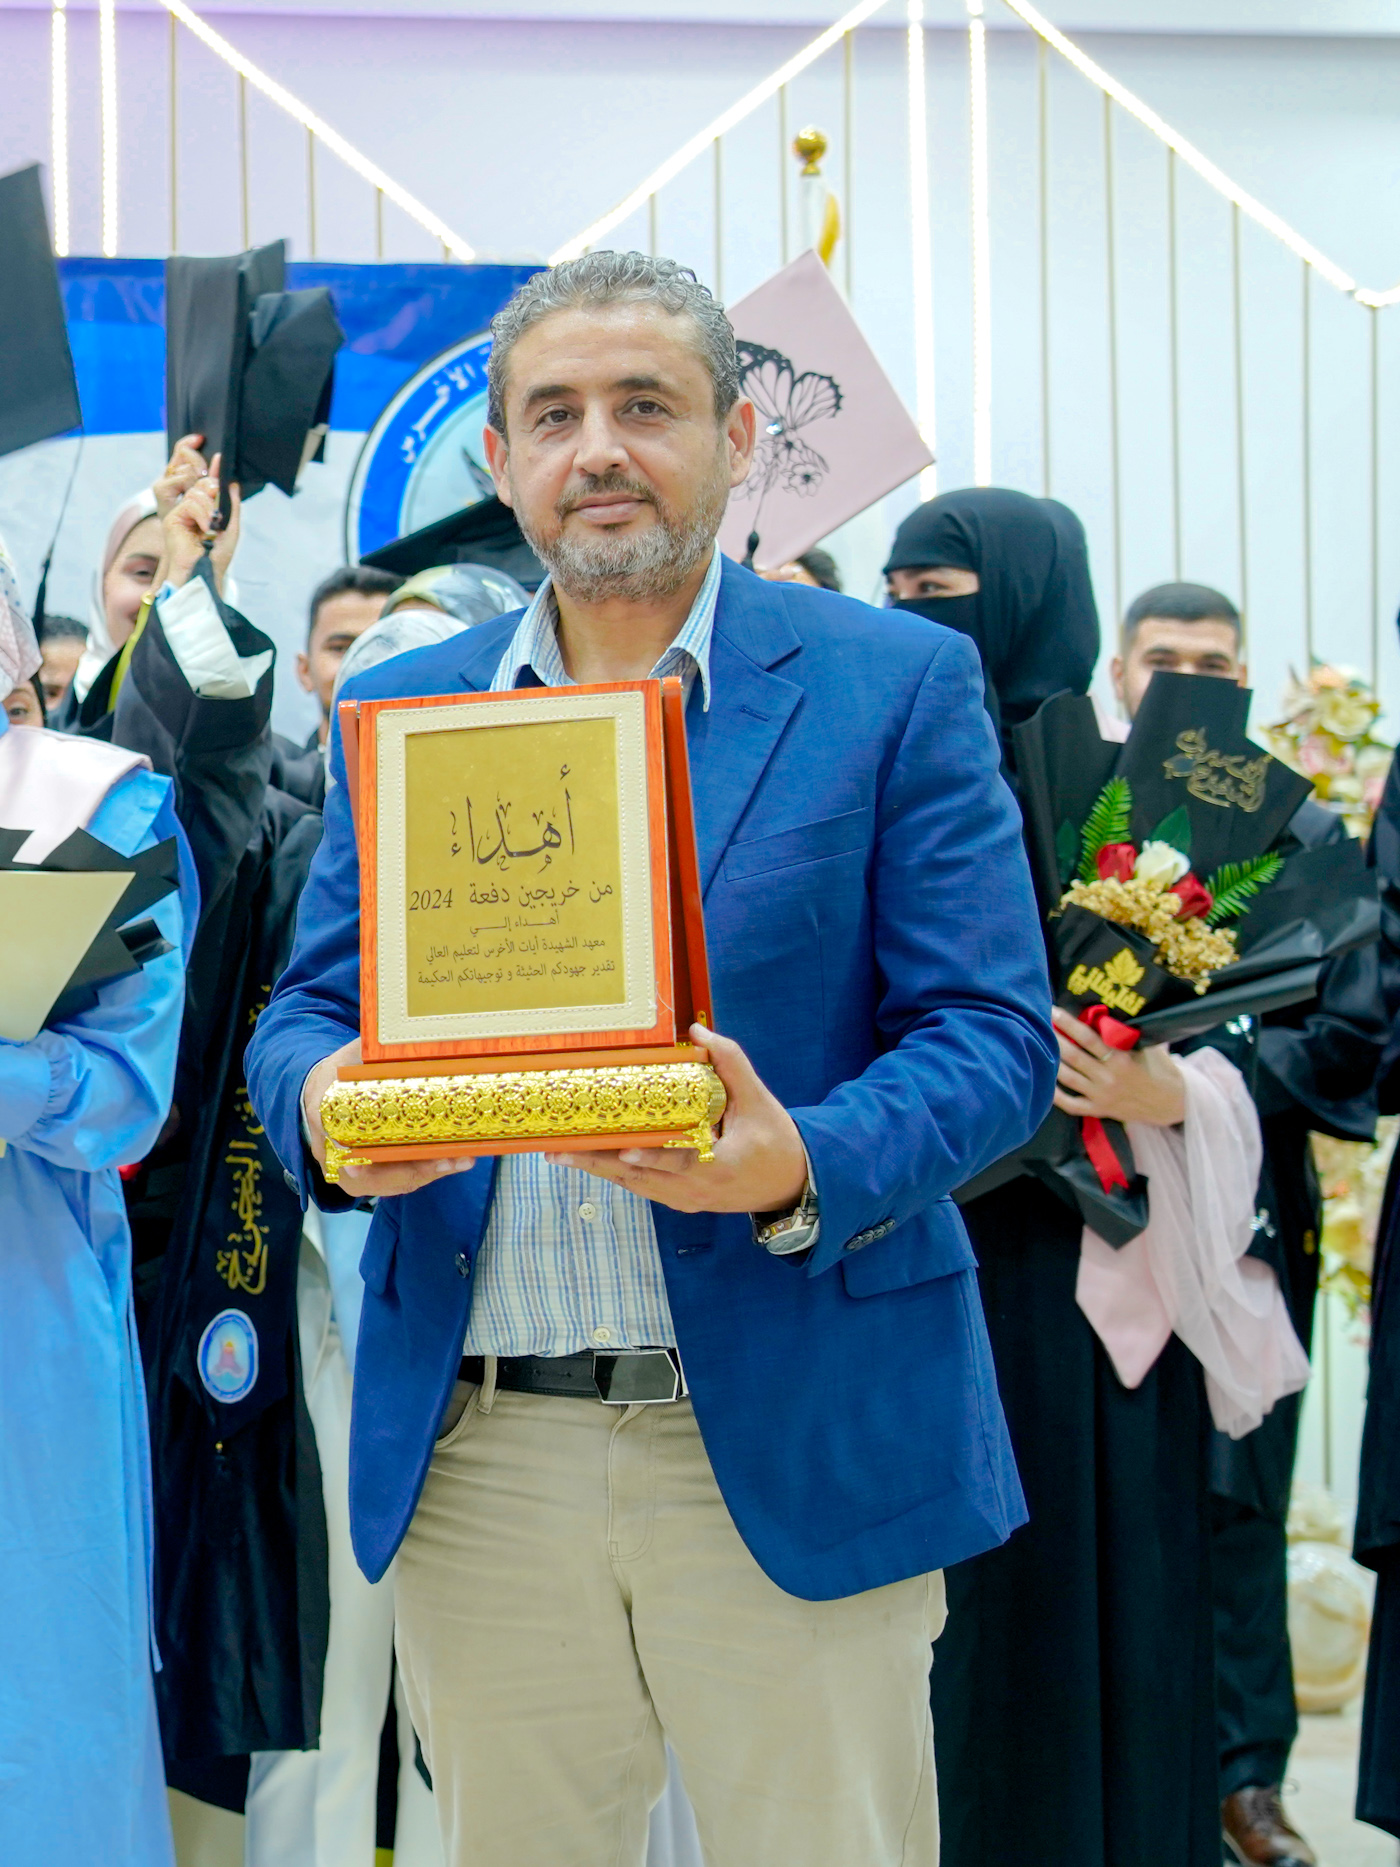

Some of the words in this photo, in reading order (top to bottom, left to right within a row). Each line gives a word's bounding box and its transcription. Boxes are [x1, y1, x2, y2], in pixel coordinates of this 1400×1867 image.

[408, 887, 453, 911] 2024
[470, 882, 510, 904] دفعة
[519, 879, 580, 911] خريجين
[589, 881, 613, 903] من
[484, 938, 515, 958] الأخرس
[542, 936, 578, 953] الشهيدة
[582, 938, 606, 951] معهد
[426, 945, 449, 965] العالي
[418, 969, 454, 988] الحكيمة
[457, 967, 503, 988] توجيهاتكم
[507, 970, 513, 981] و
[551, 961, 586, 982] جهودكم
[591, 960, 616, 977] تقدير
